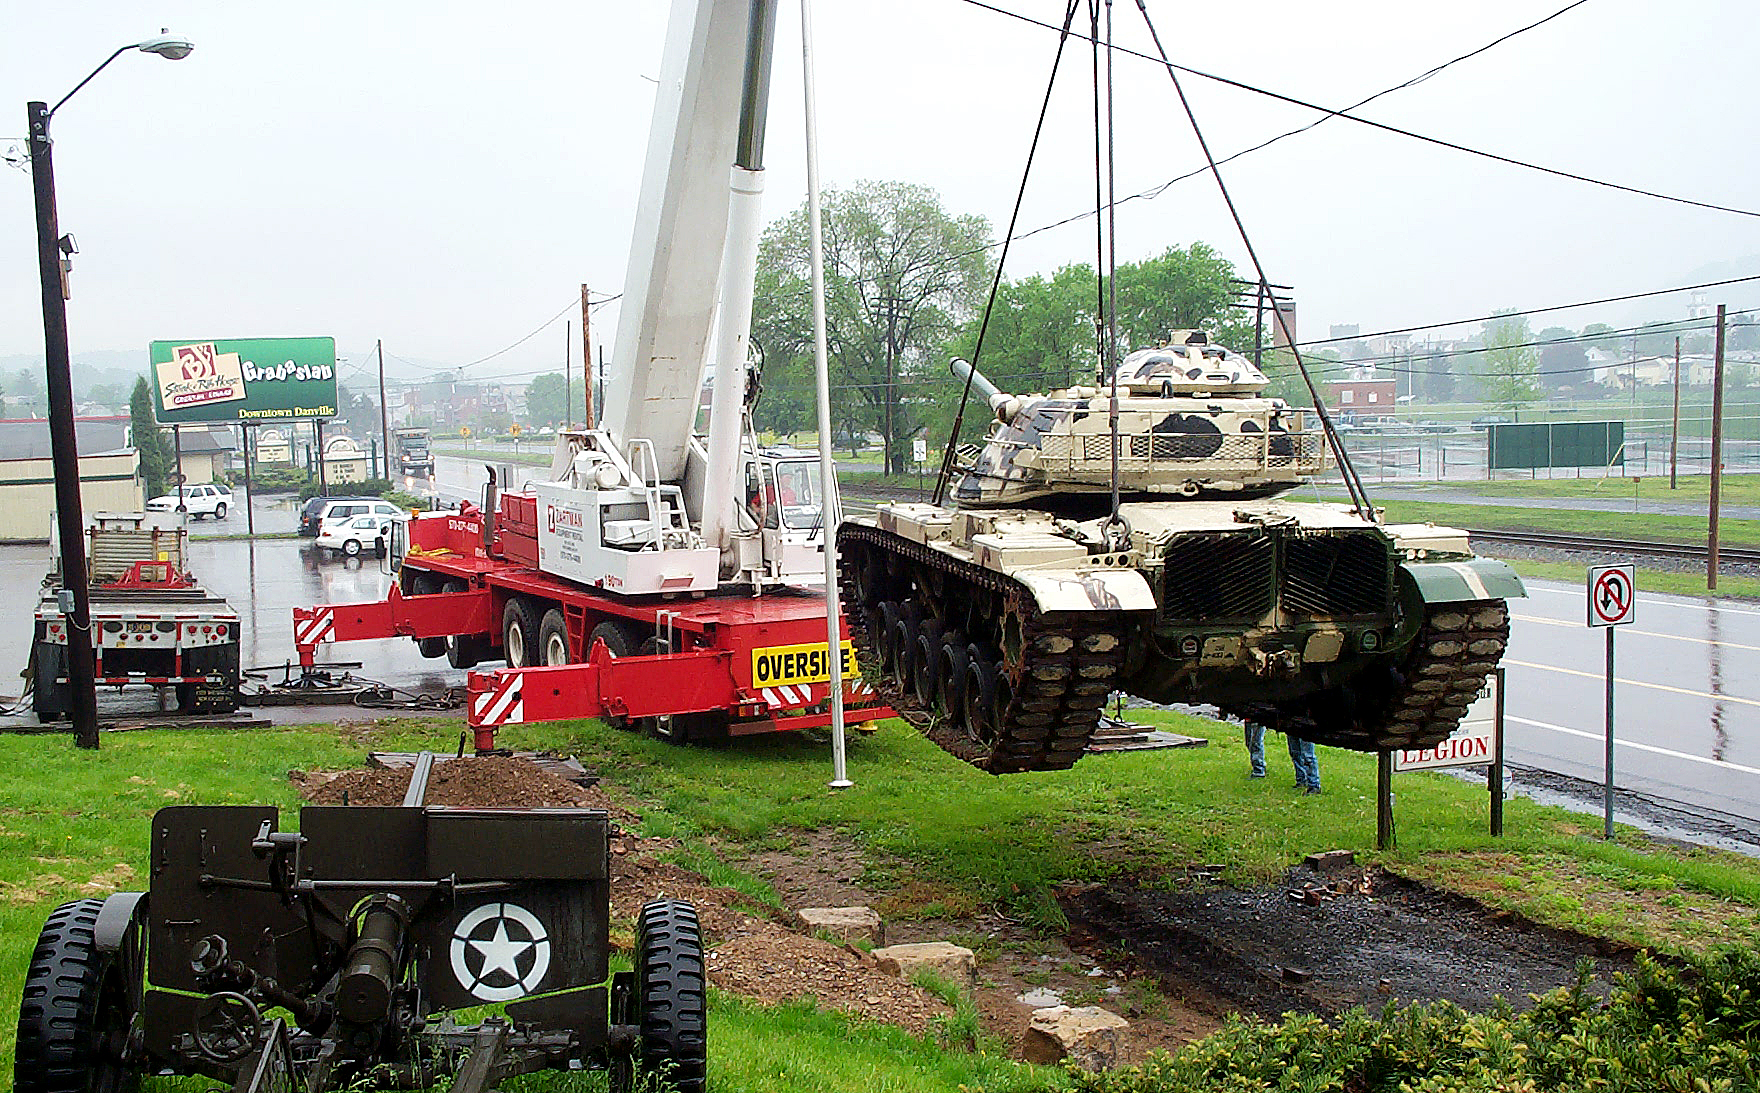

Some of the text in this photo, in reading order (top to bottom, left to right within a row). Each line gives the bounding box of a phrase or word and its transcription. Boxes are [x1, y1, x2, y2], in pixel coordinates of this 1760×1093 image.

[238, 406, 335, 419] Downtown Danville
[757, 648, 850, 682] OVERSIE
[1402, 736, 1489, 765] LEGION
